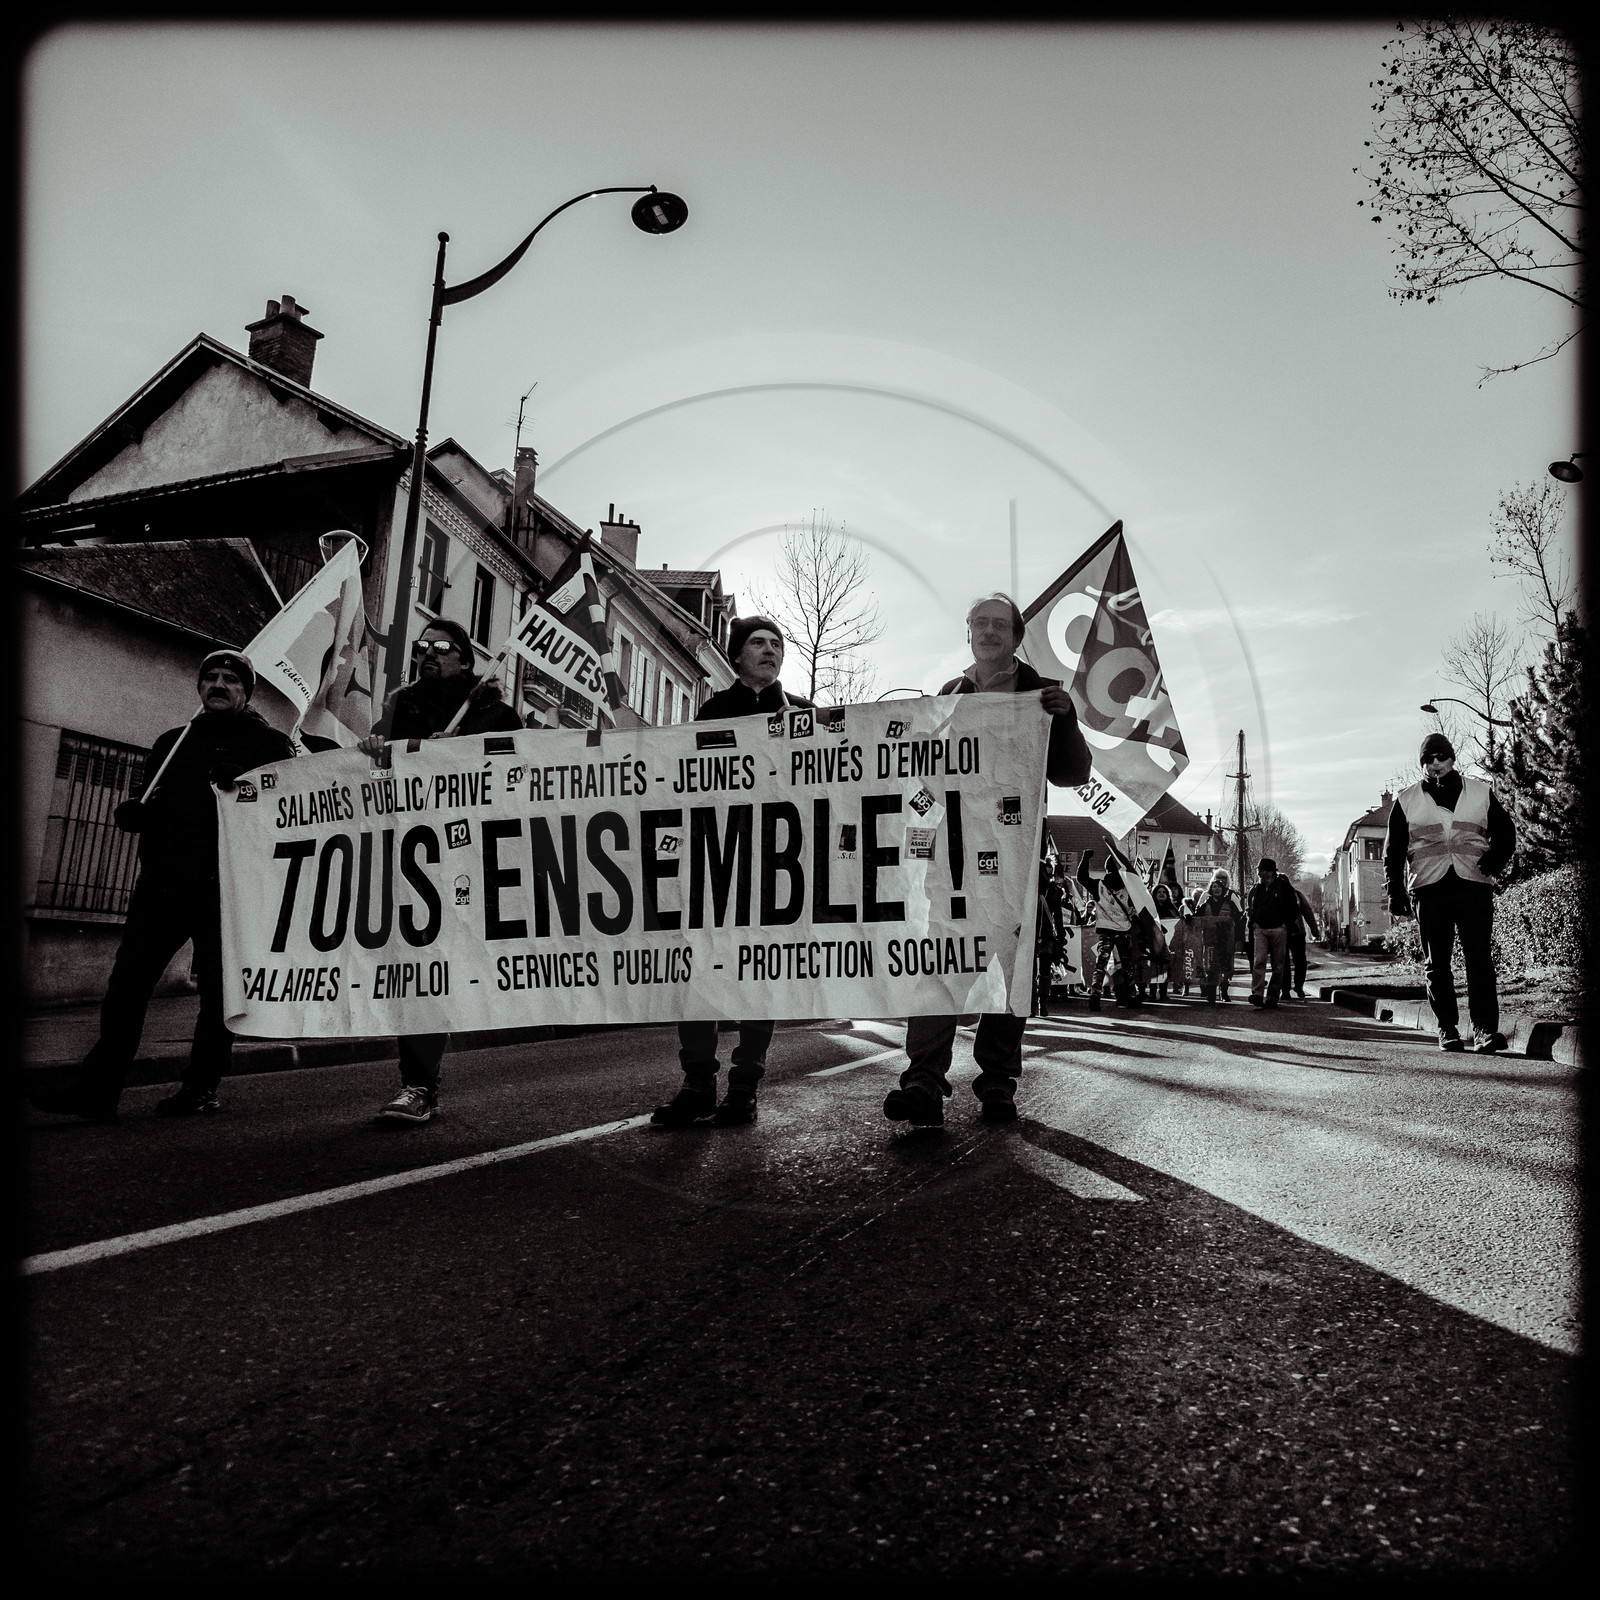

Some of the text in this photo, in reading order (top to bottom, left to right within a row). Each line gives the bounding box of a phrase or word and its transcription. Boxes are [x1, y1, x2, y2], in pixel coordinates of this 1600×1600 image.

[794, 713, 810, 732] FO
[276, 780, 353, 828] SALARIÉS
[361, 761, 492, 816] PUBLIC/PRIVÉ
[530, 754, 646, 802] RETRAITÉS
[673, 755, 754, 793] JEUNES
[792, 739, 863, 786] PRIVÉS
[878, 737, 980, 780] D'EMPLOI
[1091, 791, 1117, 815] 05
[1003, 810, 1021, 825] cgt
[451, 823, 467, 843] FO
[270, 825, 441, 953] TOUS
[481, 794, 906, 941] ENSEMBLE
[979, 856, 998, 869] cgt
[373, 961, 449, 1000] EMPLOI
[498, 952, 600, 991] SERVICES
[614, 946, 693, 986] PUBLICS
[739, 940, 873, 981] PROTECTION
[888, 936, 988, 978] SOCIALE
